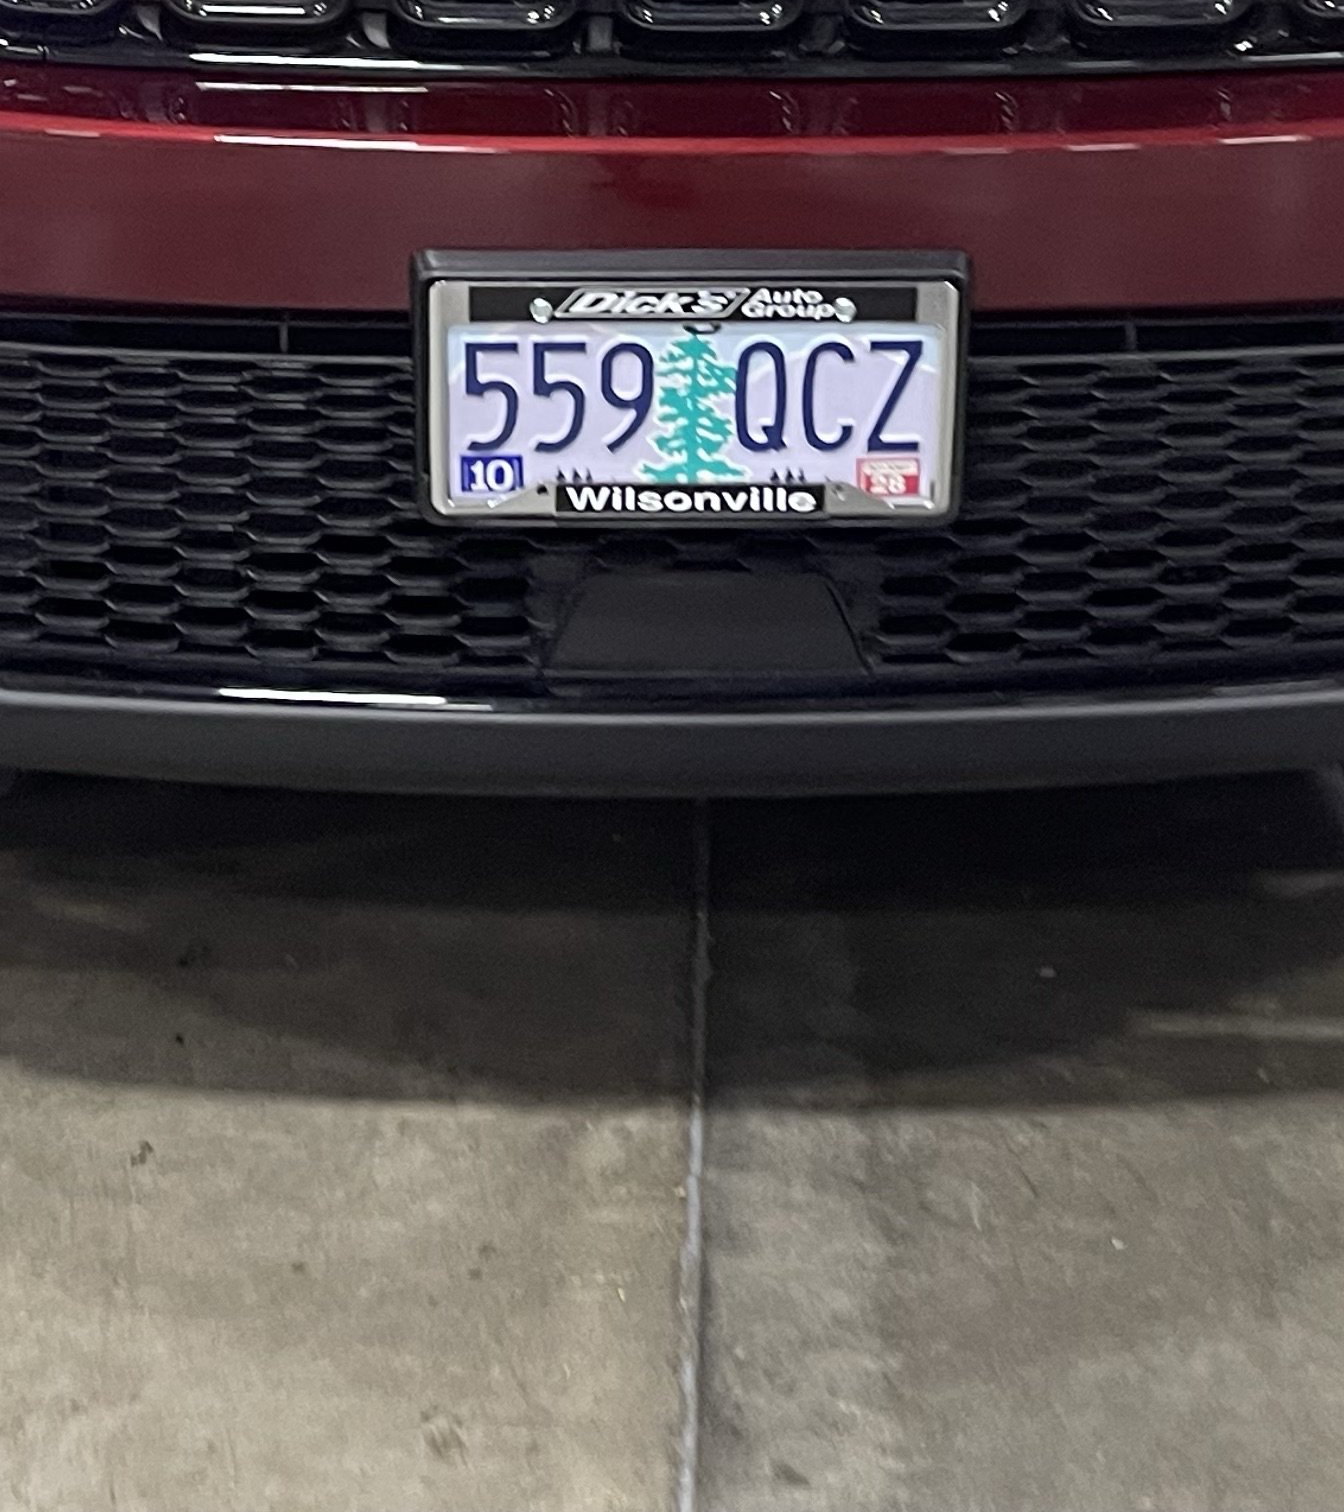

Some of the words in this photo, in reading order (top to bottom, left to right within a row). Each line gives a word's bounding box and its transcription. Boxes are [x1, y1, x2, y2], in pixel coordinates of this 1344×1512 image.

[747, 288, 824, 305] Auto
[742, 302, 836, 320] Group
[464, 341, 655, 453] 559
[735, 340, 924, 453] QCZ
[471, 460, 514, 491] 10
[566, 486, 818, 514] Wilsonville
